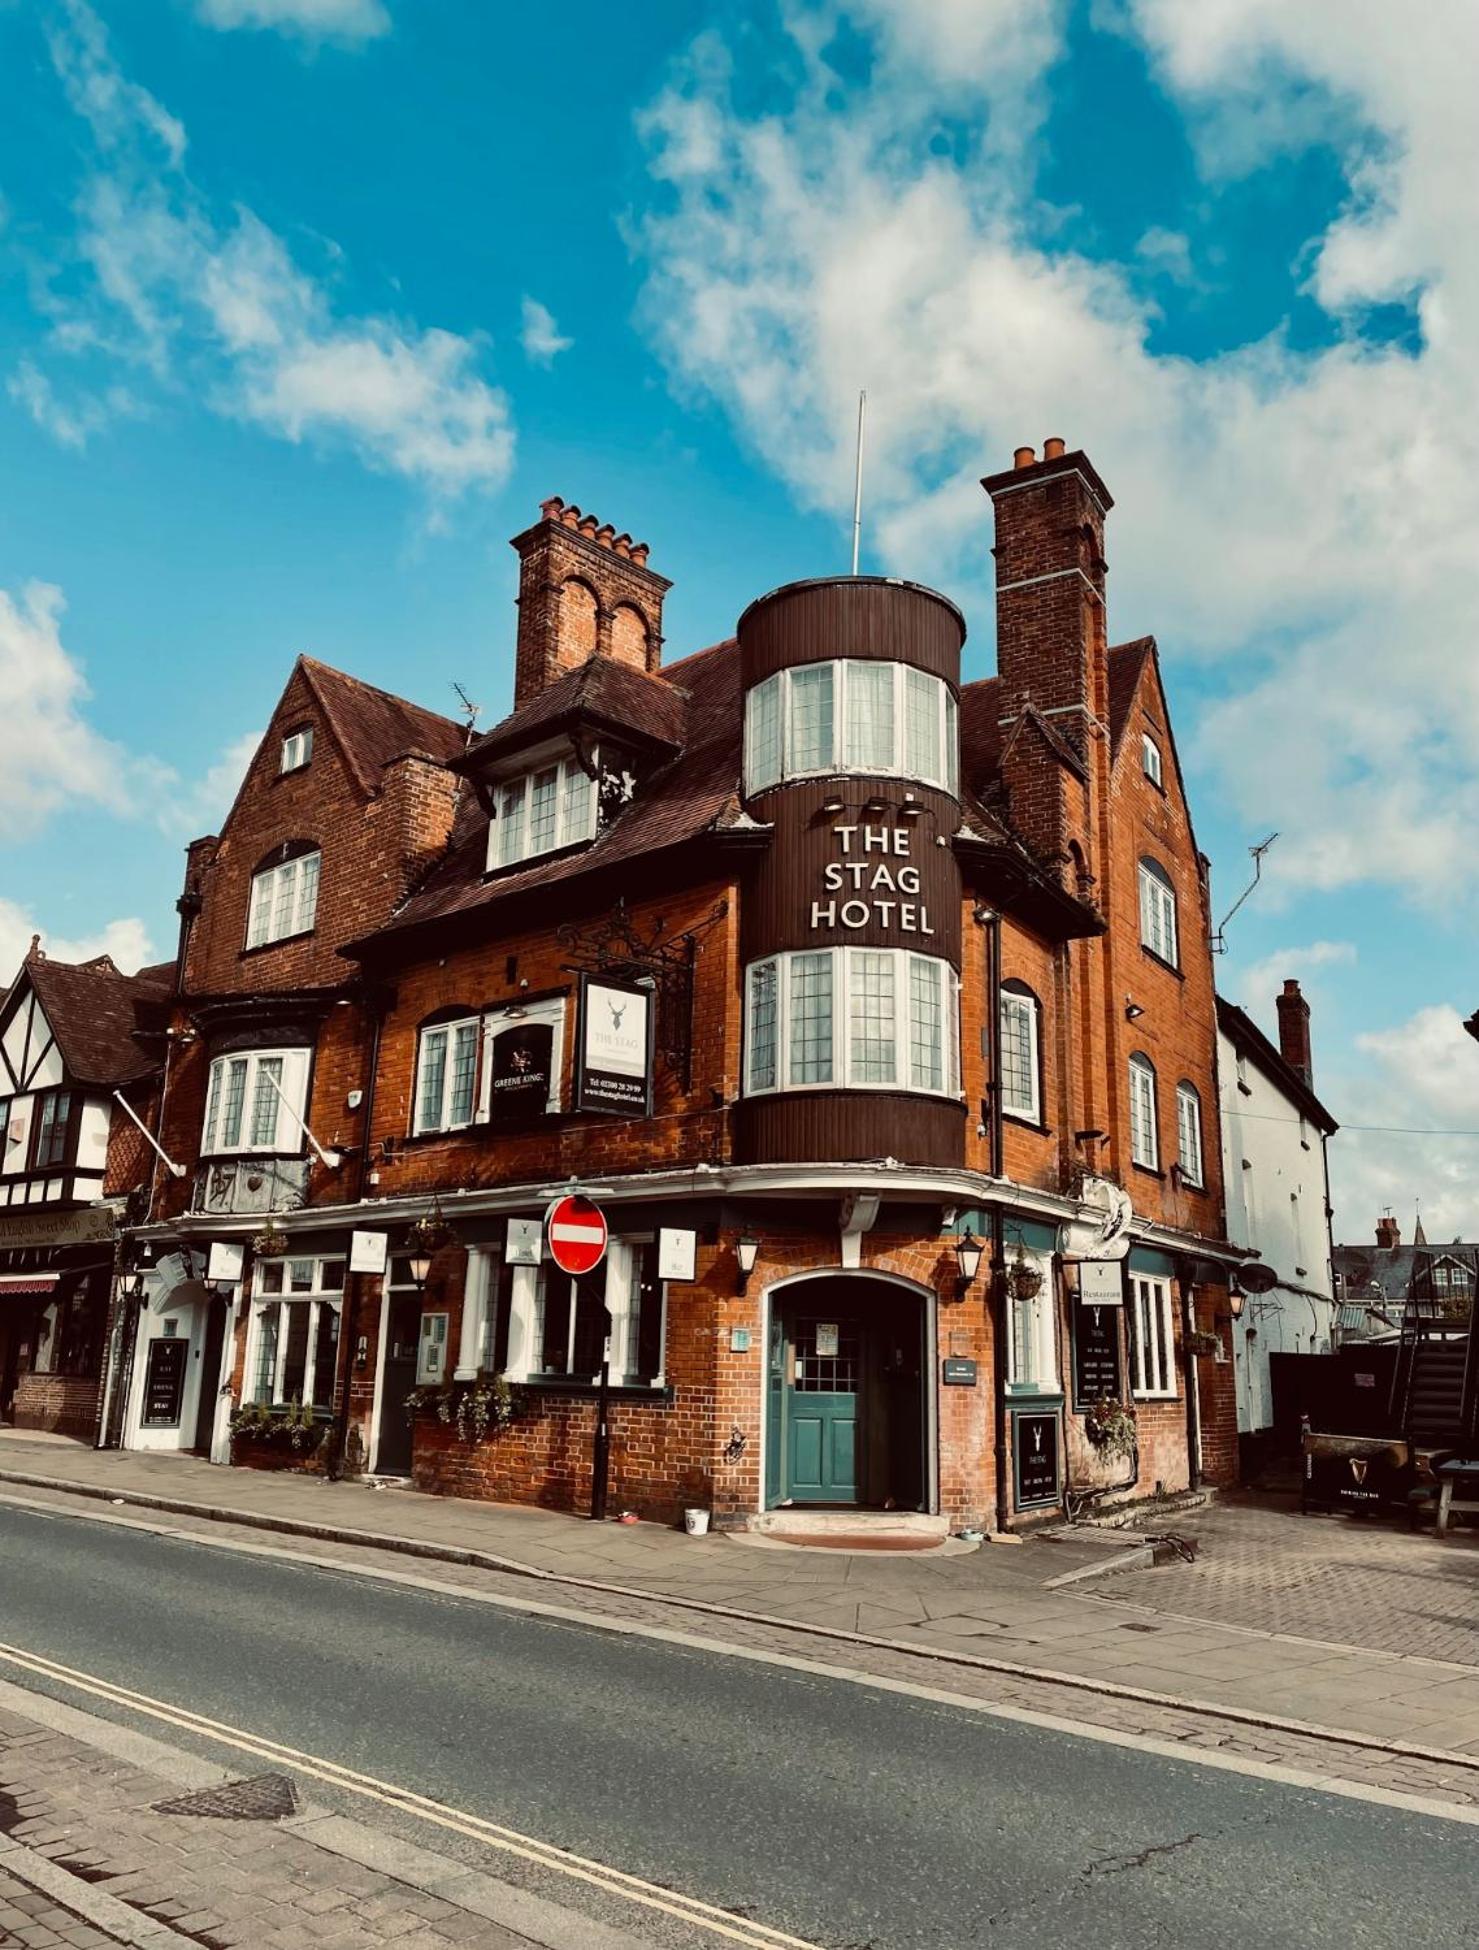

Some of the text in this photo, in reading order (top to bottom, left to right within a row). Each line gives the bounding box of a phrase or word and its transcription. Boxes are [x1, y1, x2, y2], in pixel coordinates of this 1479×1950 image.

[834, 825, 910, 856] THE
[824, 862, 920, 894] STAG
[810, 900, 935, 935] HOTEL
[595, 1031, 612, 1046] THE
[494, 1076, 521, 1088] GREENE
[59, 1216, 80, 1235] Shop
[1083, 1290, 1120, 1298] Restaurant
